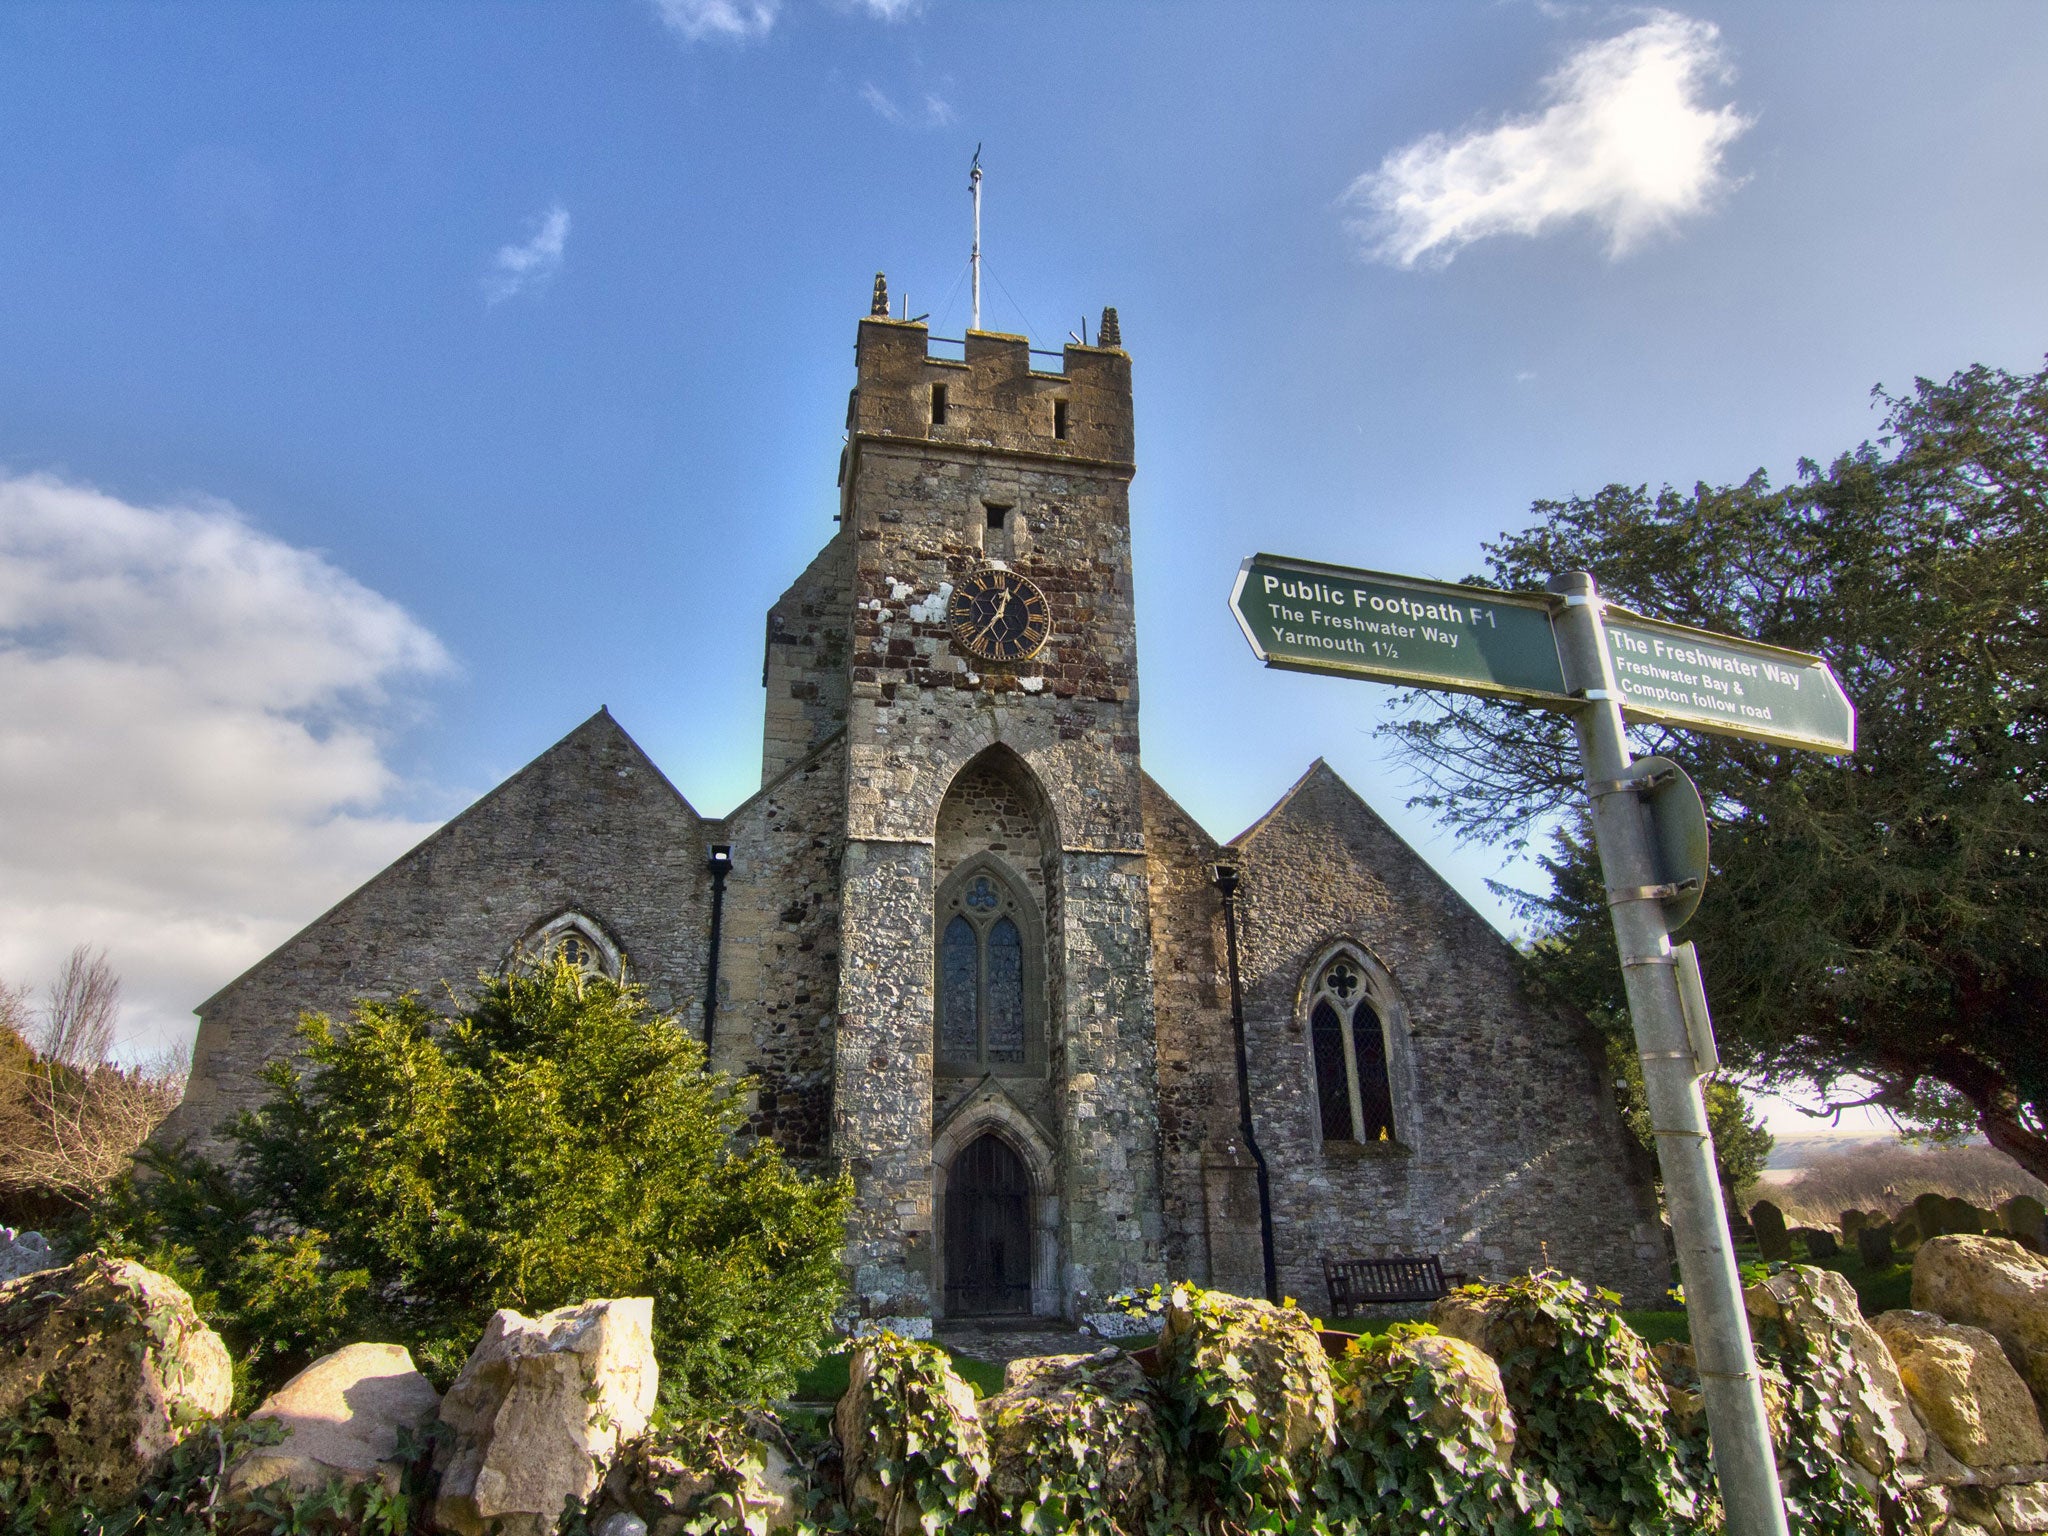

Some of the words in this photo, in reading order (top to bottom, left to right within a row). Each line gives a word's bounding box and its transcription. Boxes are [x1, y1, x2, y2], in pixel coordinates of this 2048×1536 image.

[1263, 575, 1345, 605] Public
[1353, 590, 1463, 623] Footpath
[1469, 607, 1496, 629] F1
[1268, 603, 1305, 623] The
[1311, 610, 1416, 639] Freshwater
[1421, 626, 1458, 648] Way
[1272, 626, 1365, 654] Yarmouth
[1609, 629, 1648, 655] The
[1653, 639, 1758, 678] Freshwater
[1761, 663, 1800, 690] Way
[1617, 657, 1698, 686] Freshwater
[1702, 674, 1730, 695] Bay
[1733, 682, 1744, 696] &
[1621, 678, 1689, 704] Compton
[1692, 691, 1736, 713] follow
[1740, 704, 1772, 720] road
